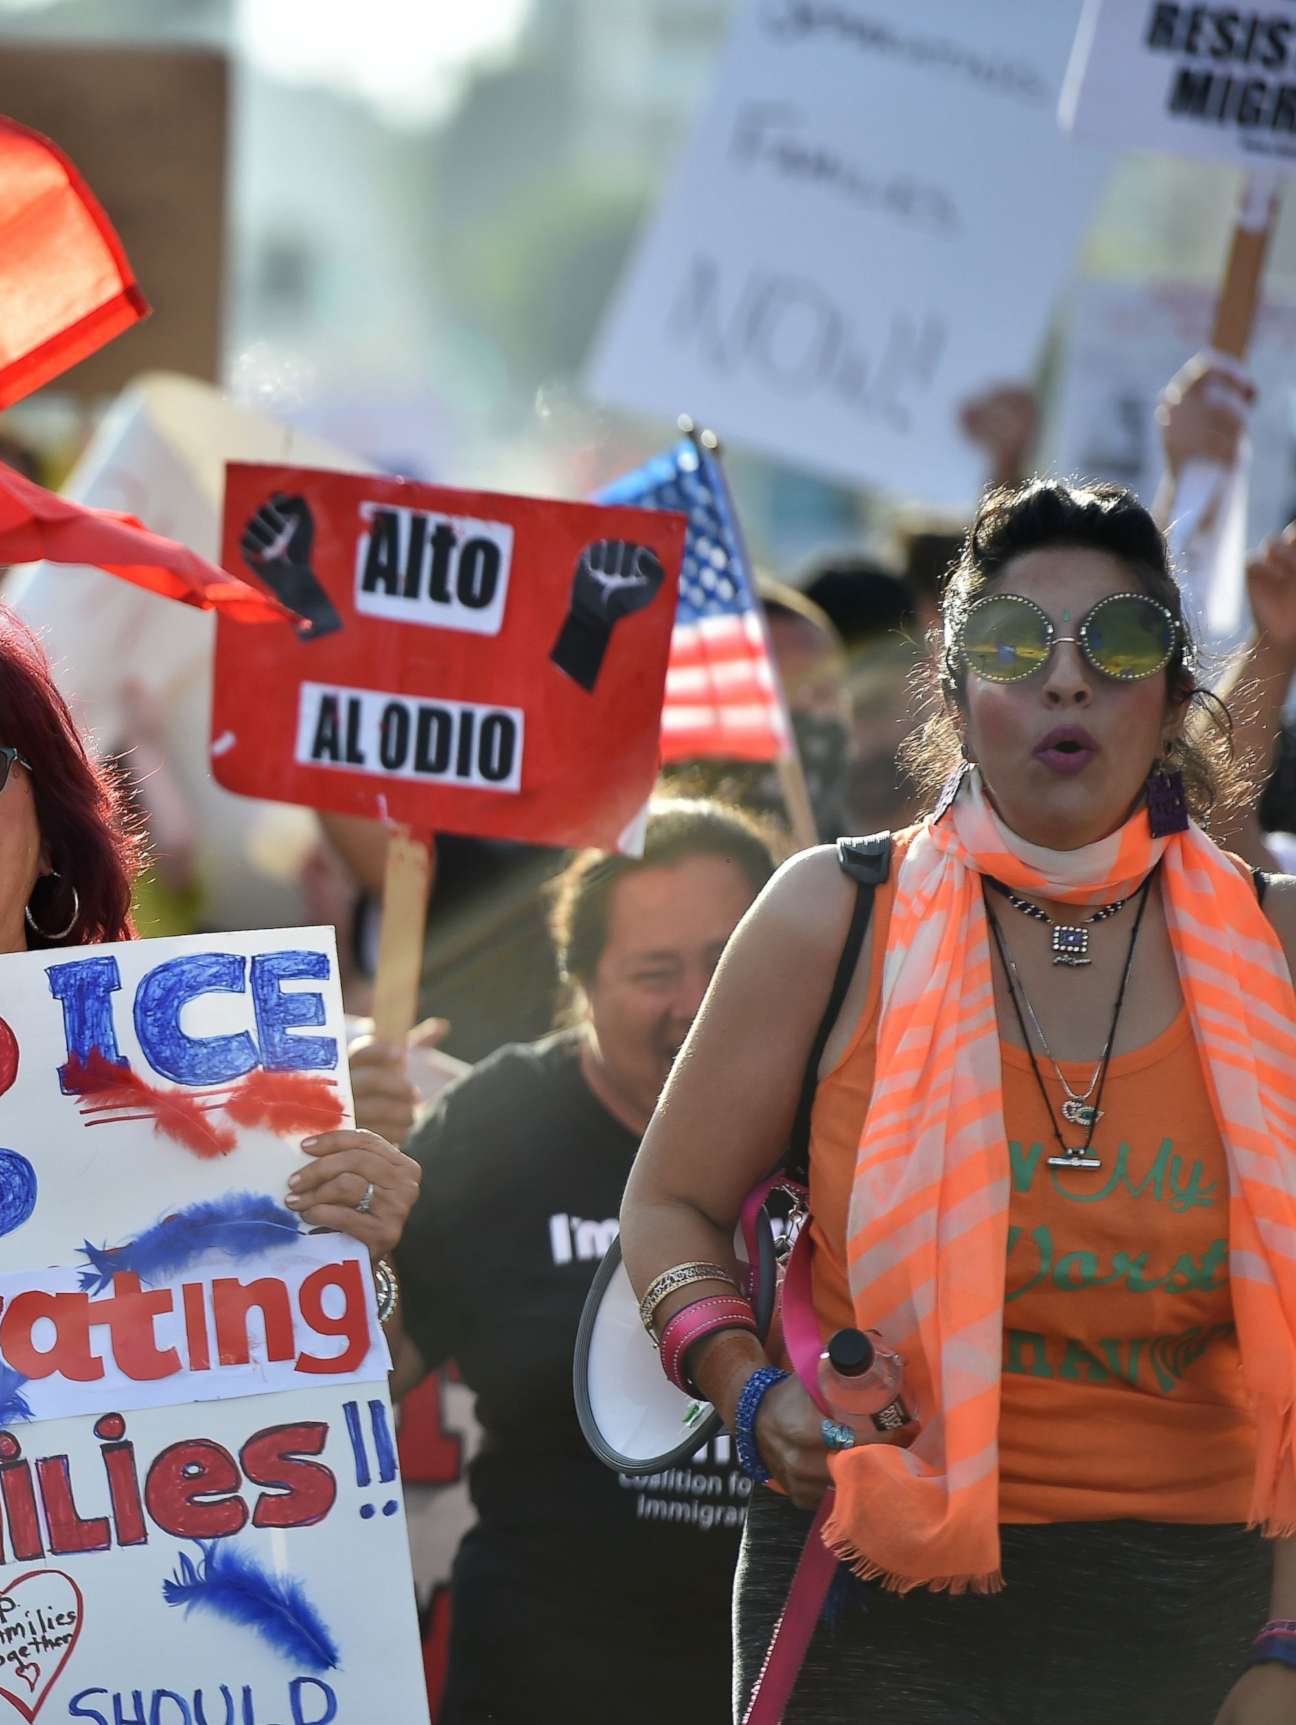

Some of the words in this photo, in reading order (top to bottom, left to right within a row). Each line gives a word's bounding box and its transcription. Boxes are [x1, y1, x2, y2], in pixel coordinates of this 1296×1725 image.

[362, 510, 501, 609] Alto
[311, 695, 365, 764] AL
[379, 702, 517, 783] ODIO
[45, 950, 338, 1096] ICE
